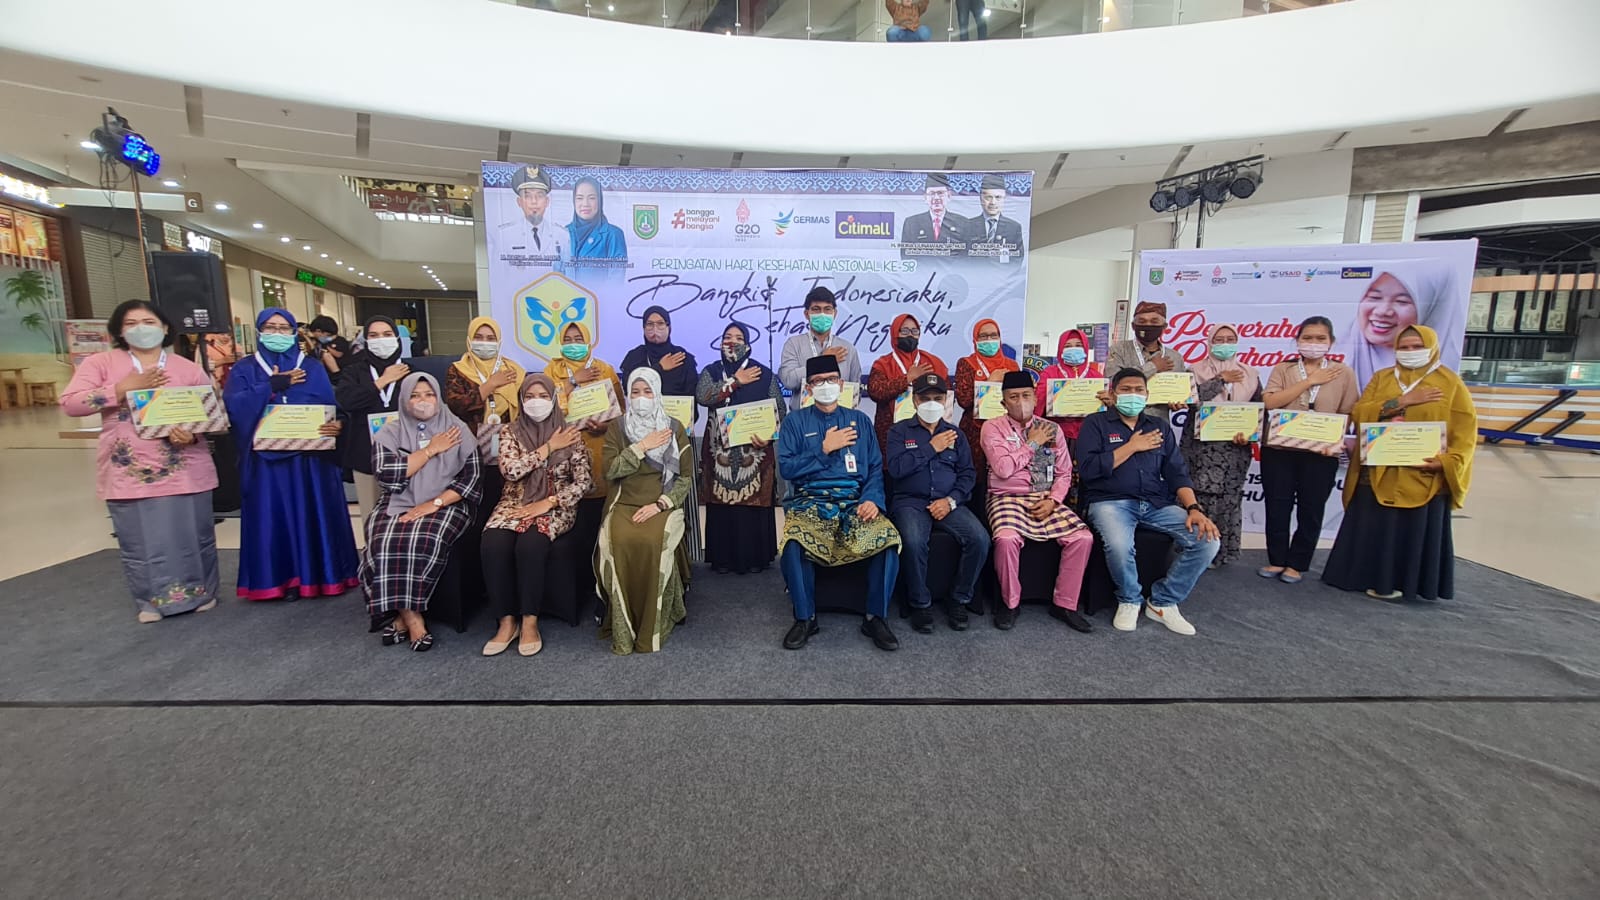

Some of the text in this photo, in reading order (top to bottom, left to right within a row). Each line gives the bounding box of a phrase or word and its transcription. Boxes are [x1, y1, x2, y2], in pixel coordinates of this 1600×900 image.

[188, 198, 198, 208] G
[793, 216, 830, 224] GERMAS
[686, 223, 714, 231] bangsa
[838, 219, 891, 235] Citimall
[651, 258, 721, 270] PERINGATAN
[725, 259, 753, 270] HARI
[757, 259, 819, 271] KESEHATAN
[823, 260, 880, 272] NASIONAL
